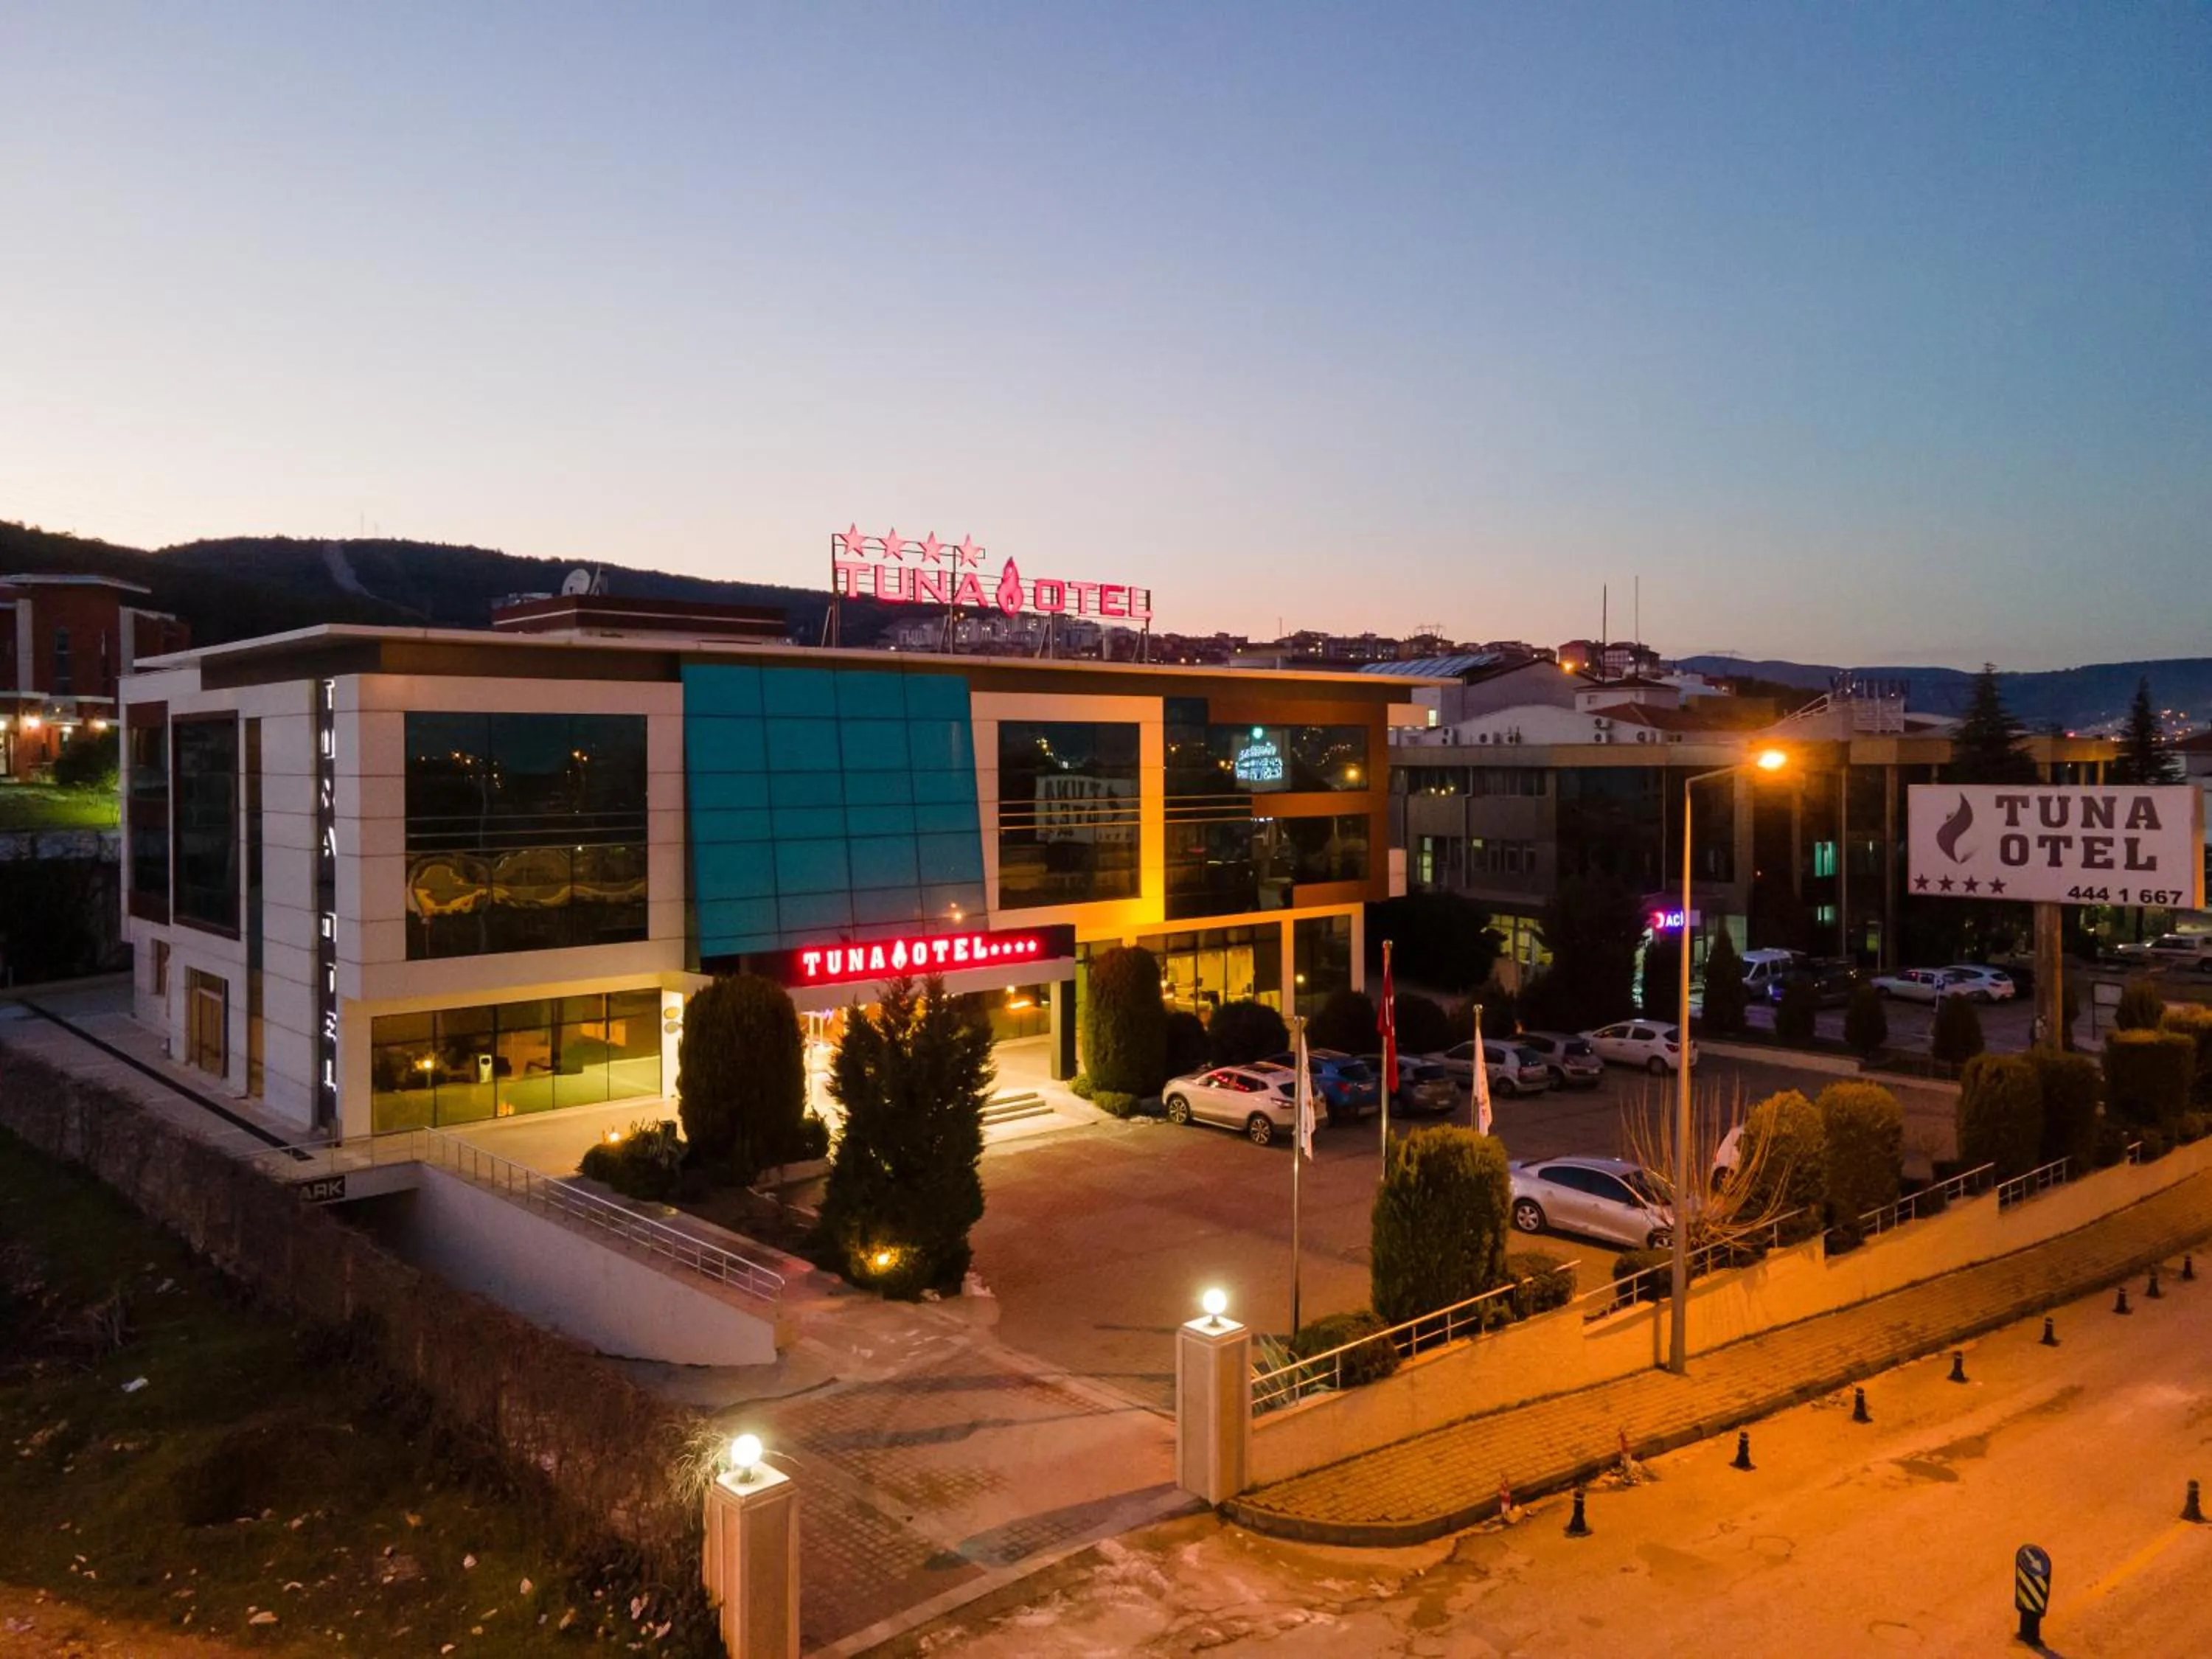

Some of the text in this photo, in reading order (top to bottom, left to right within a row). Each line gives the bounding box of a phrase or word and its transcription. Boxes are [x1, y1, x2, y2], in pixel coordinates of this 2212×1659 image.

[835, 560, 1154, 621] TUNA OTEL
[1995, 795, 2162, 830] TUNA
[2000, 834, 2157, 872] OTEL
[2067, 886, 2183, 905] 444 1 667
[803, 936, 987, 977] TUNA OTEL
[299, 1180, 342, 1201] ARK
